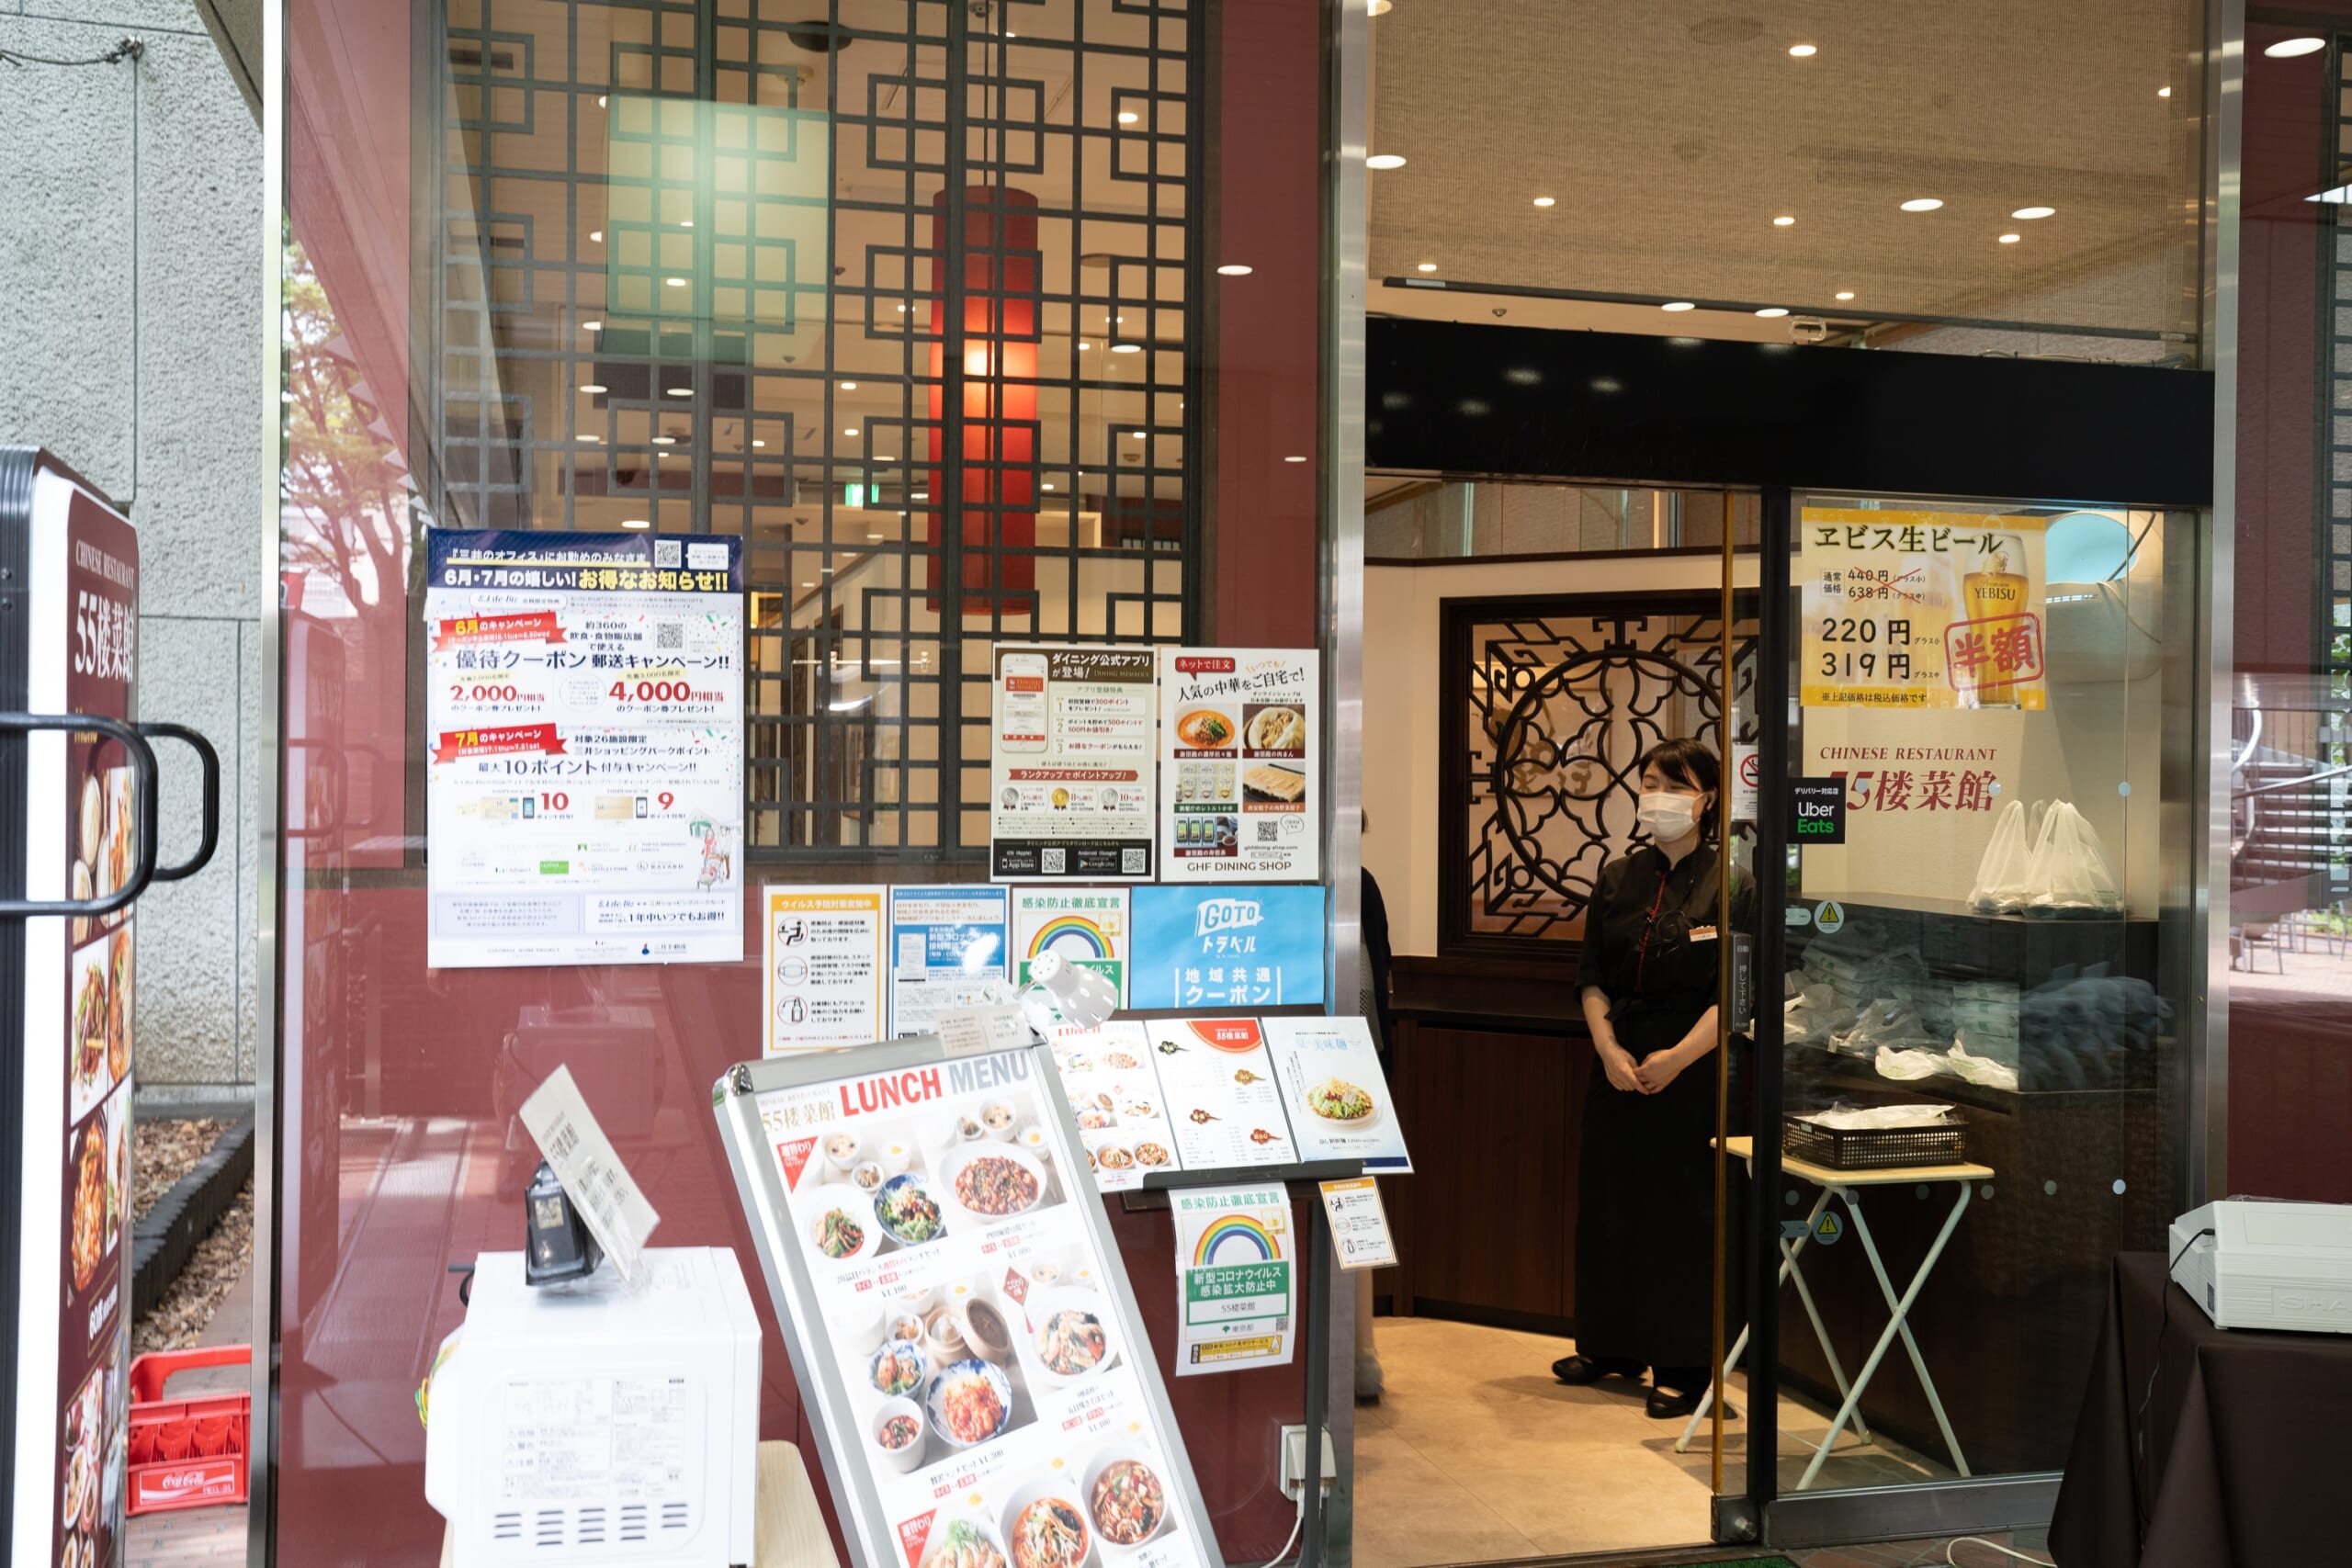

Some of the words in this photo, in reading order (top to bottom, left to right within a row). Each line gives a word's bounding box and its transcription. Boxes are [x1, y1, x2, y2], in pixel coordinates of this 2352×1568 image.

[75, 539, 102, 576] CHINESE
[103, 551, 135, 591] RESTAURANT
[1823, 571, 1842, 581] 通常
[1823, 584, 1842, 593] 価格
[1974, 587, 2016, 601] YEBISU
[74, 590, 135, 684] 55楼菜館
[1052, 653, 1149, 667] ダイニング公式アプリ
[1953, 624, 2035, 678] 半額
[1179, 660, 1232, 671] ネットで注文
[1178, 667, 1306, 704] 人気の中華をご自宅で!
[1819, 746, 1889, 761] CHINESE
[1894, 747, 1997, 761] RESTAURANT
[541, 792, 570, 811] 10
[657, 792, 675, 812] 9
[1797, 801, 1835, 817] Uber
[1797, 818, 1835, 834] Eats
[1187, 862, 1212, 872] GHF
[1215, 861, 1256, 872] DINING
[1259, 861, 1292, 871] SHOP
[1022, 897, 1121, 909] 感染防止徹底宣言
[1202, 936, 1257, 954] トラベル
[1184, 966, 1272, 984] 地域共通
[1185, 985, 1272, 1005] クーポン
[839, 1066, 943, 1118] LUNCH
[946, 1050, 1030, 1096] MENU
[1181, 1190, 1282, 1211] 感染防止徹底宣言
[1193, 1266, 1283, 1285] 新型コロナウイルス
[1199, 1280, 1277, 1297] 感染拡大防止中
